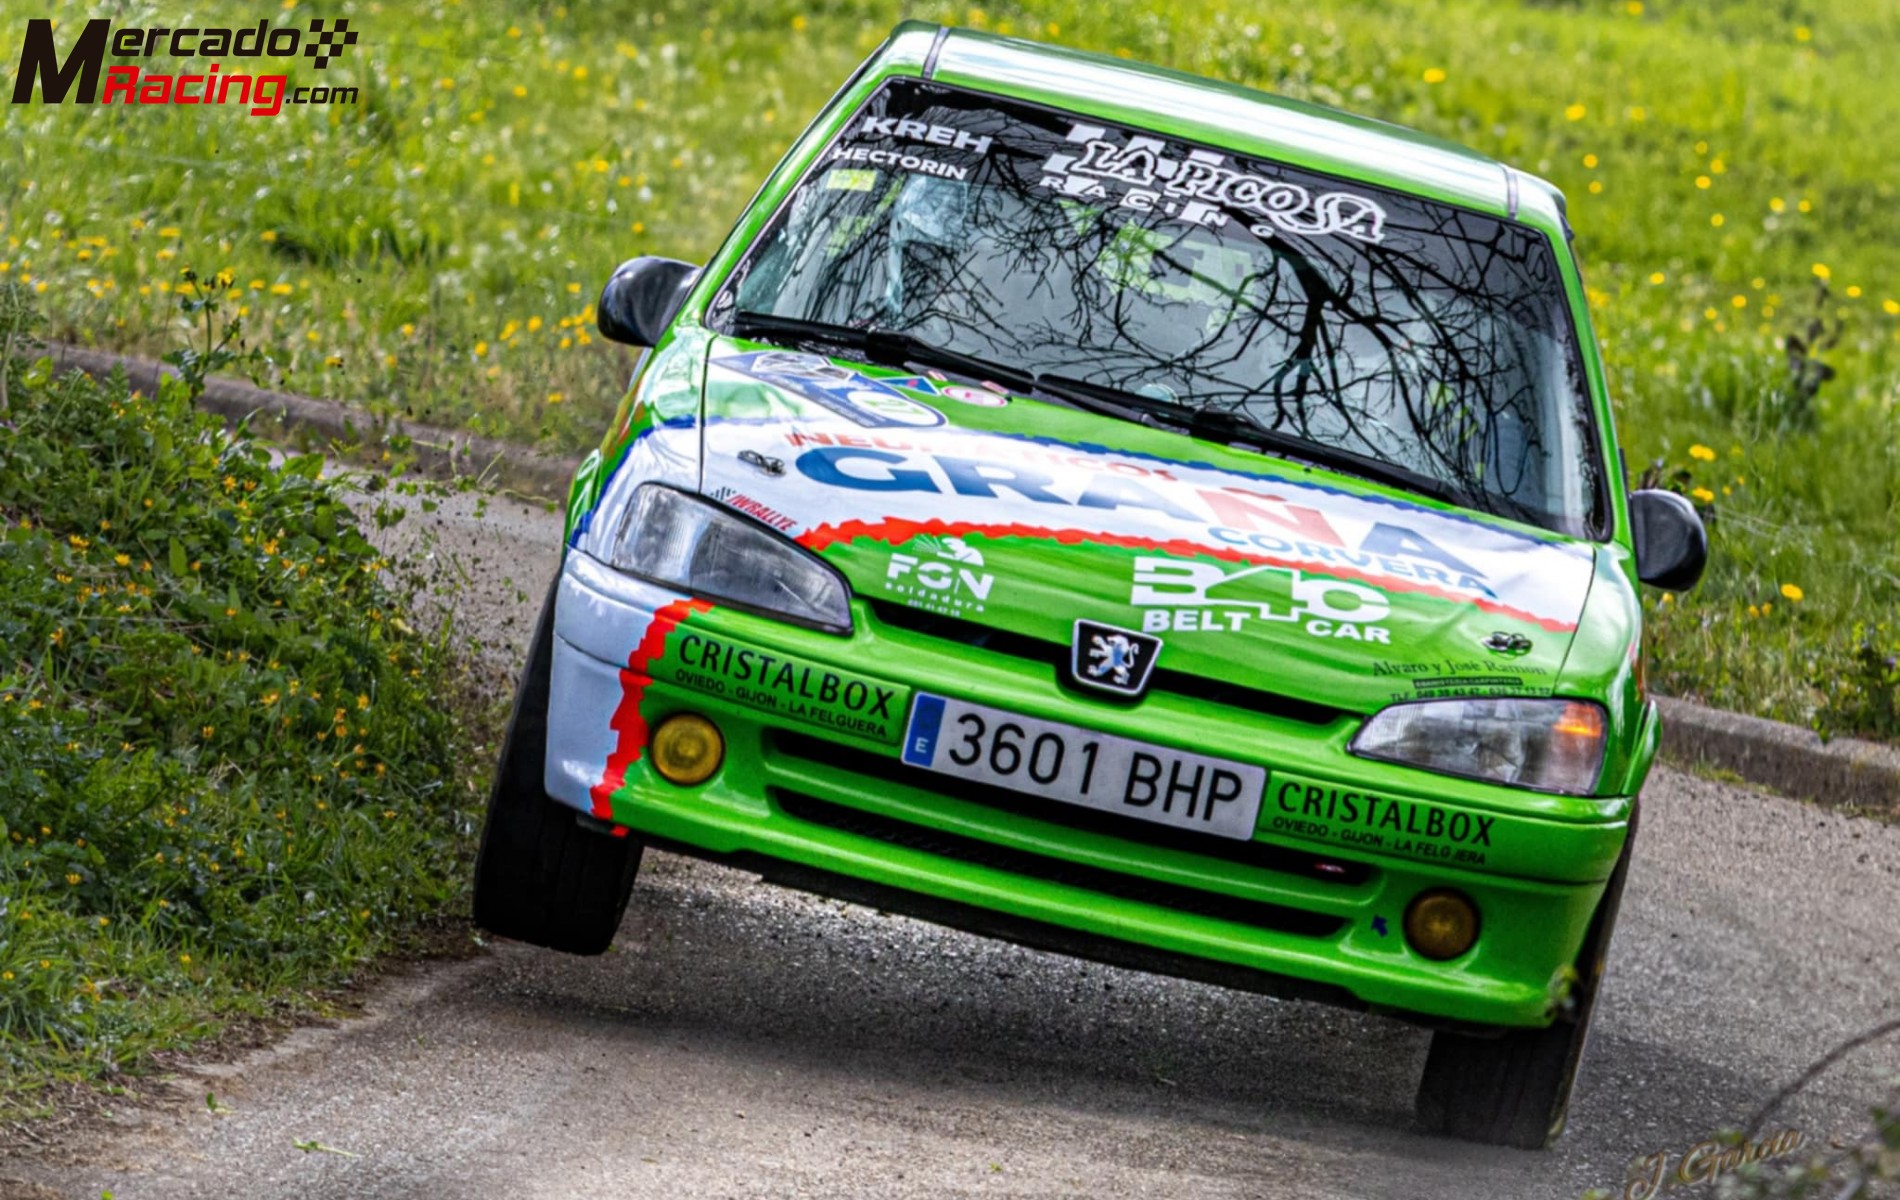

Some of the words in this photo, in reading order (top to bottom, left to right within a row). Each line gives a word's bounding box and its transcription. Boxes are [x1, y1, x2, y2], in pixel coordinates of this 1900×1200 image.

[861, 116, 993, 154] KREH
[832, 148, 968, 181] HECTORIN
[784, 432, 1179, 482] NEUTICOS
[795, 446, 1490, 579] GRAÑA
[1207, 526, 1499, 600] CORVERA
[1143, 609, 1250, 634] BELT
[1306, 619, 1392, 645] CAR
[679, 634, 895, 720] CRISTALBOX
[1431, 662, 1442, 675] y
[675, 668, 725, 694] OVIEDO
[788, 700, 807, 716] LA
[808, 706, 888, 738] FELGUERA
[914, 737, 928, 754] E
[949, 712, 1099, 795] 3601
[1123, 751, 1243, 822] BHP
[1273, 816, 1329, 838] OVIEDO
[1395, 838, 1414, 852] LA
[1278, 782, 1495, 847] CRISTALBOX
